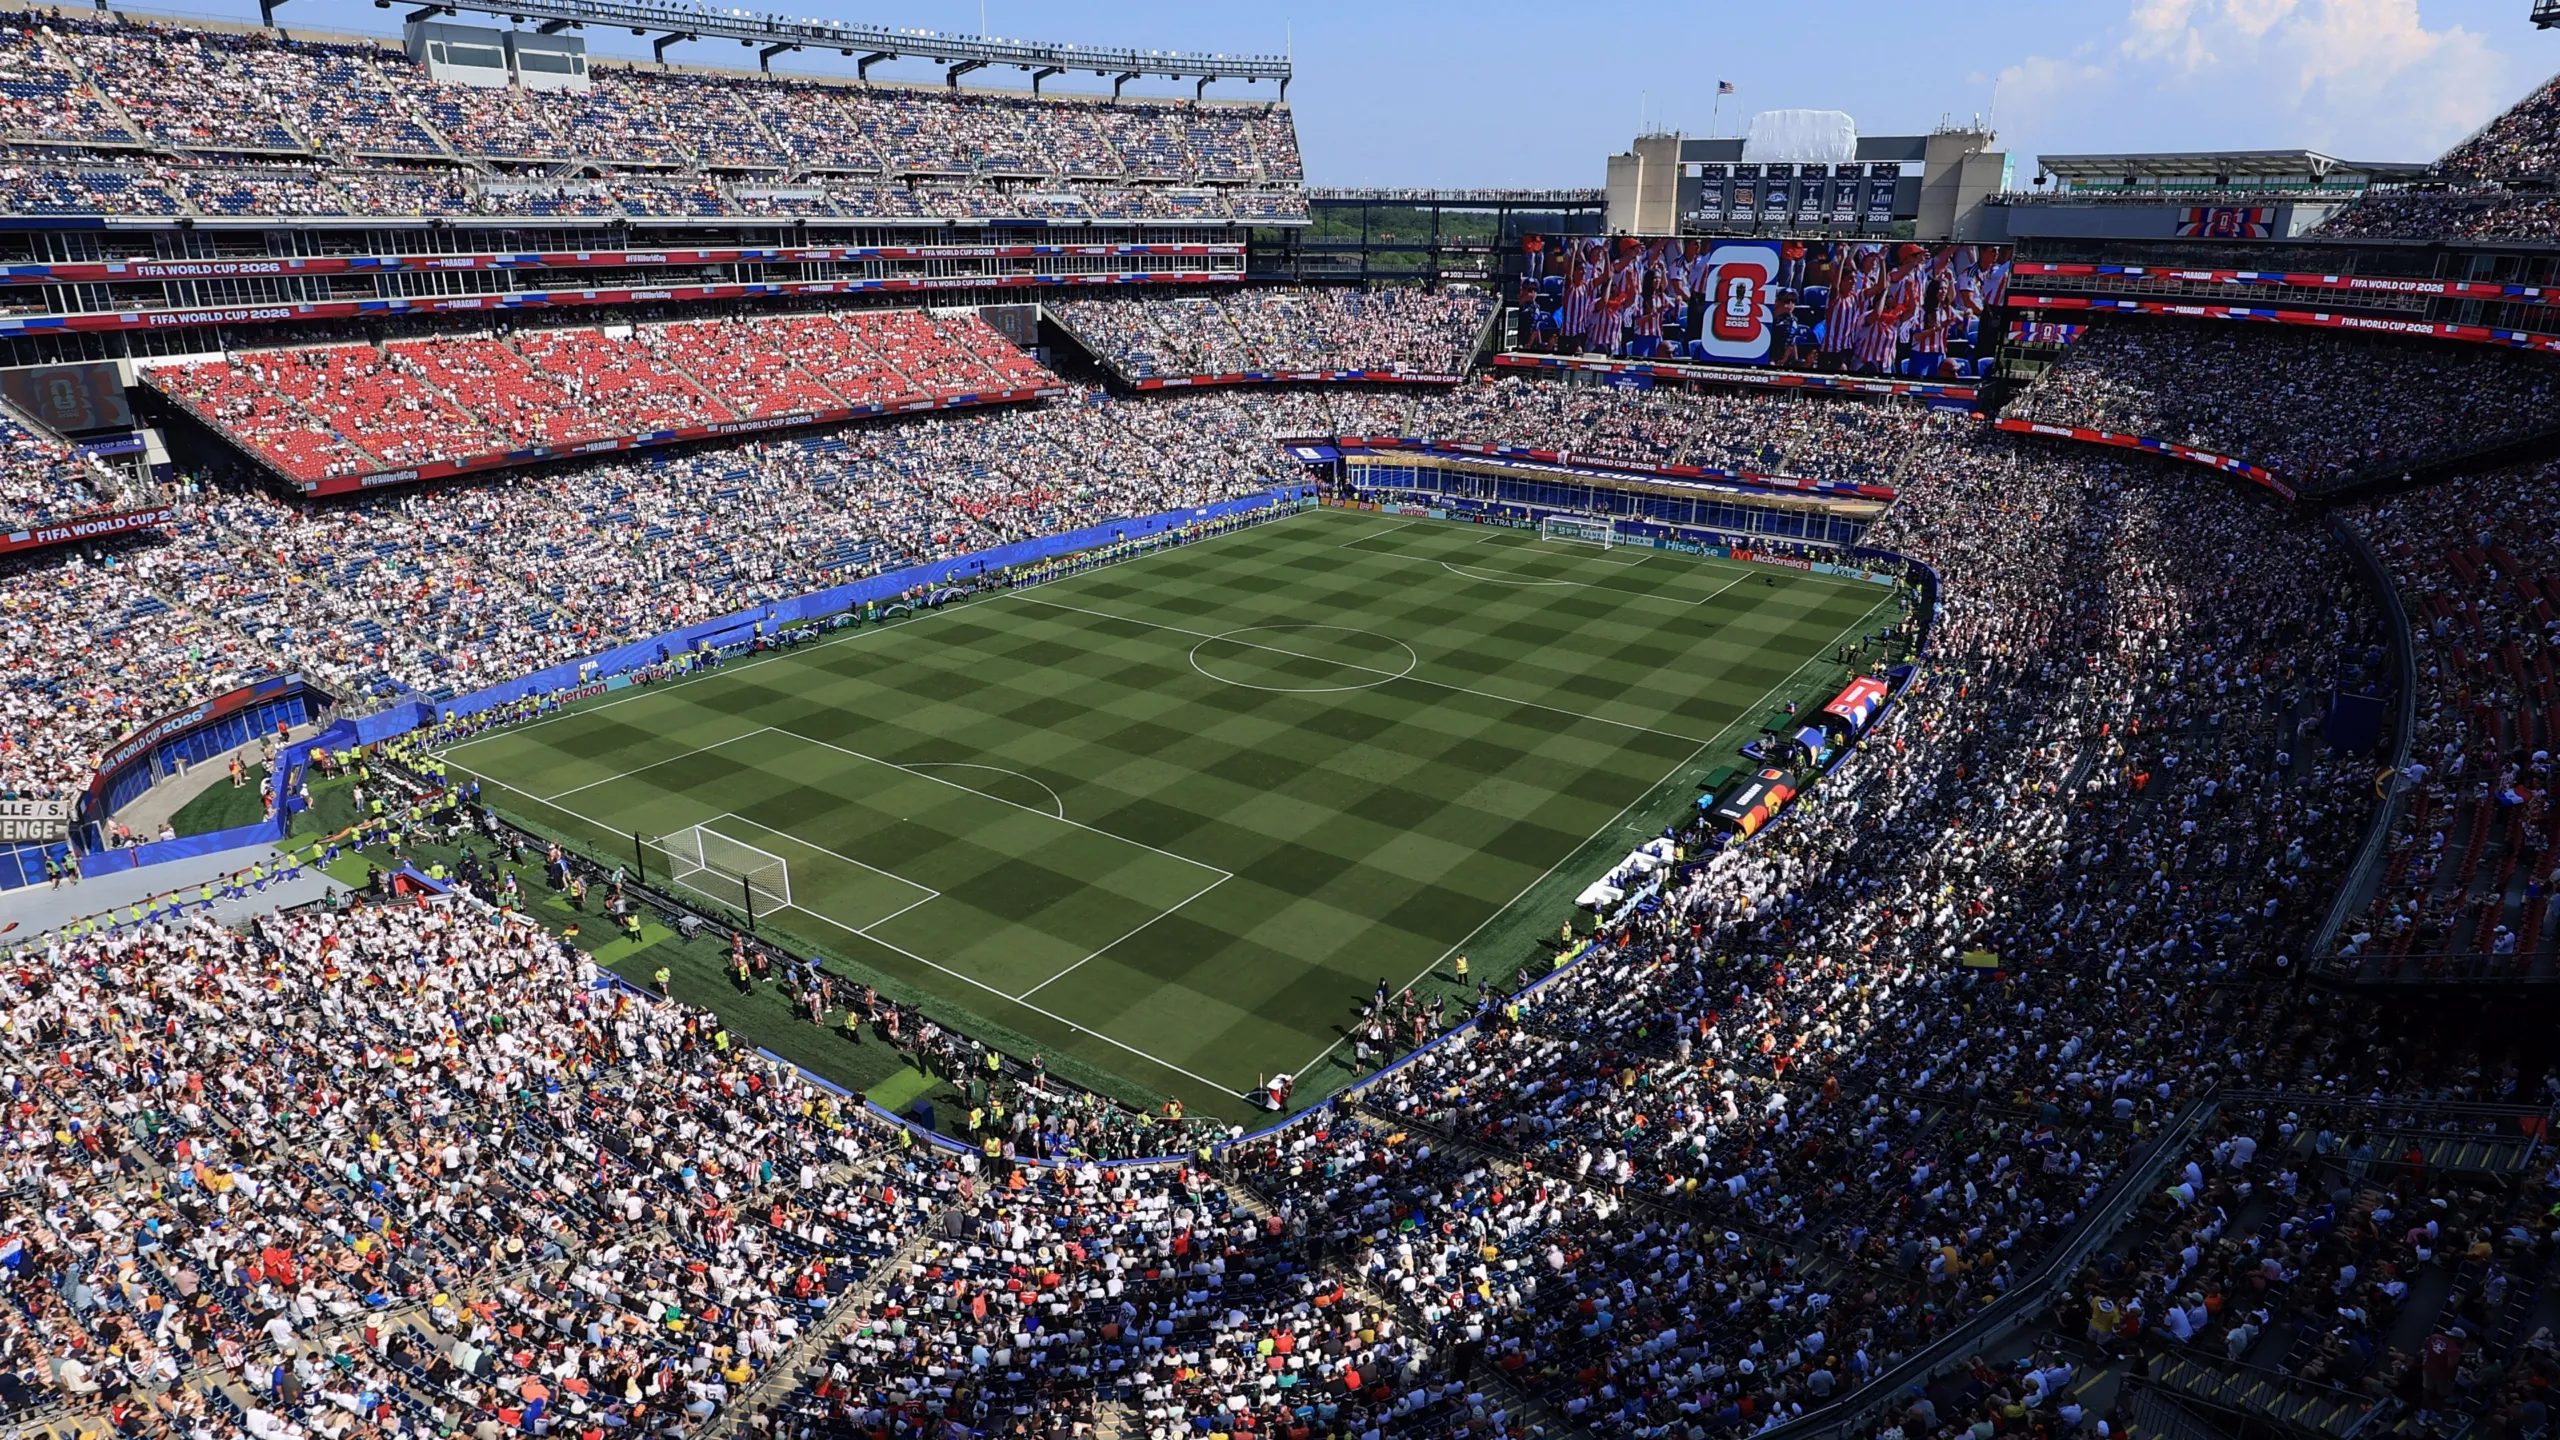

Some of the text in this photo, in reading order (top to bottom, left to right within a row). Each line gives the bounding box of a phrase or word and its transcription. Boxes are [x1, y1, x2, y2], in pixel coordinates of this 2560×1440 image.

[440, 258, 474, 268] PARAGUAY
[137, 263, 281, 276] FIFA WORLD CUP 2026
[2183, 271, 2212, 280] PARAGUAY
[2350, 279, 2444, 292] FIFA WORLD CUP 2026
[448, 298, 482, 308] PARAGUAY
[149, 308, 291, 325] FIFA WORLD CUP 2026
[2175, 306, 2205, 315] PARAGUAY
[2341, 318, 2434, 333] FIFA WORLD CUP 2026
[739, 420, 767, 430] WORLD
[769, 418, 784, 427] CUP
[785, 415, 812, 424] 2026
[116, 439, 141, 447] 2026
[586, 440, 618, 452] PARAGUAY
[1587, 457, 1614, 465] WORLD
[1630, 462, 1657, 470] 2026
[361, 470, 418, 486] #FIFAWorldCup
[1459, 457, 1739, 492] FIFA WORLD CUP 2026
[1770, 477, 1798, 486] PARAGUAY
[1400, 507, 1429, 517] verizon
[37, 528, 71, 542] FIFA
[72, 518, 126, 535] WORLD
[128, 512, 156, 526] CUP
[1483, 517, 1511, 527] ULTRA
[1614, 535, 1644, 544] AMRICA
[1753, 554, 1809, 570] McDonald's
[1830, 567, 1856, 577] Dove
[579, 660, 598, 671] FIFA
[558, 682, 607, 704] verizon
[101, 710, 203, 776] FIFA WORLD CUP 2026
[0, 804, 31, 816] LLE
[48, 804, 63, 816] S.
[0, 820, 54, 839] ENGE
